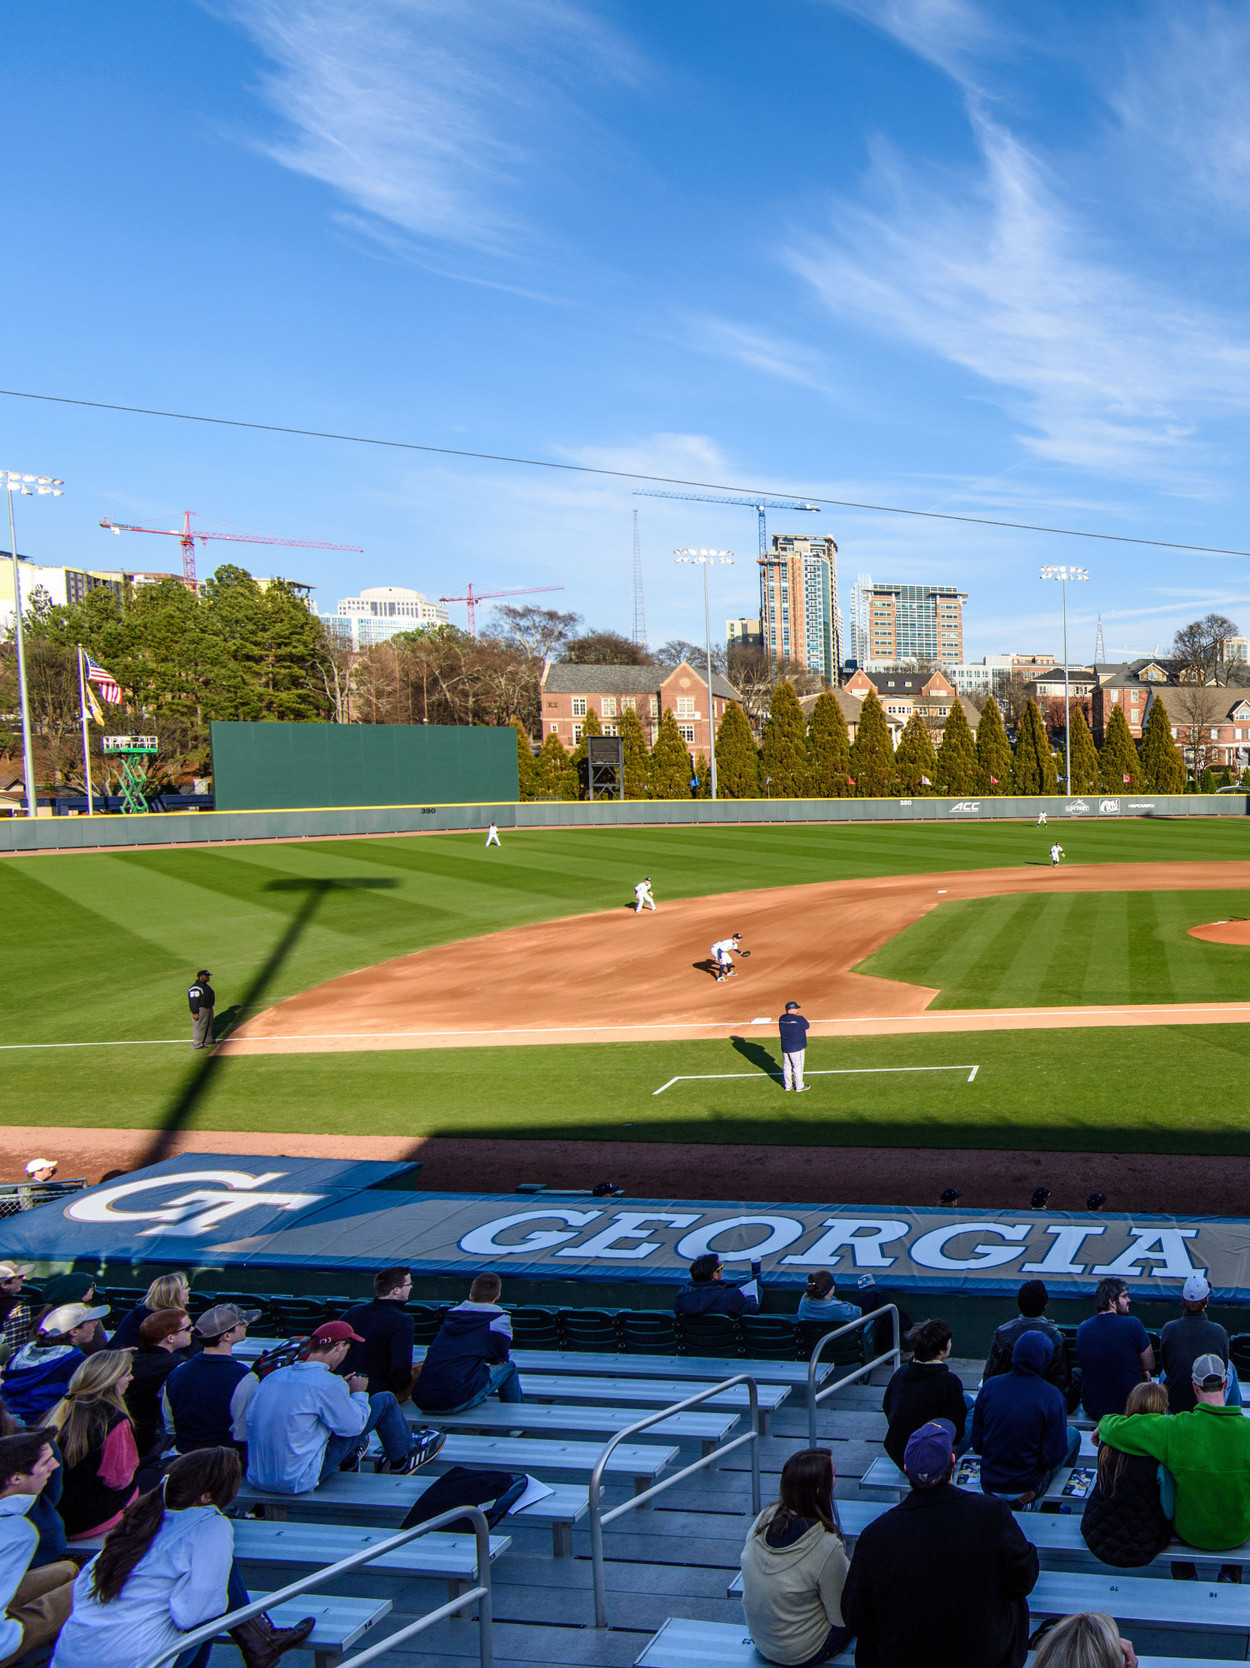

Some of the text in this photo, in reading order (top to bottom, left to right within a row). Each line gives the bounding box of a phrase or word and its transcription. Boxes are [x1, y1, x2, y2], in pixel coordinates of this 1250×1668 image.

[950, 802, 980, 811] ACC
[63, 1170, 331, 1237] GT
[457, 1209, 1209, 1278] GEORGIA
